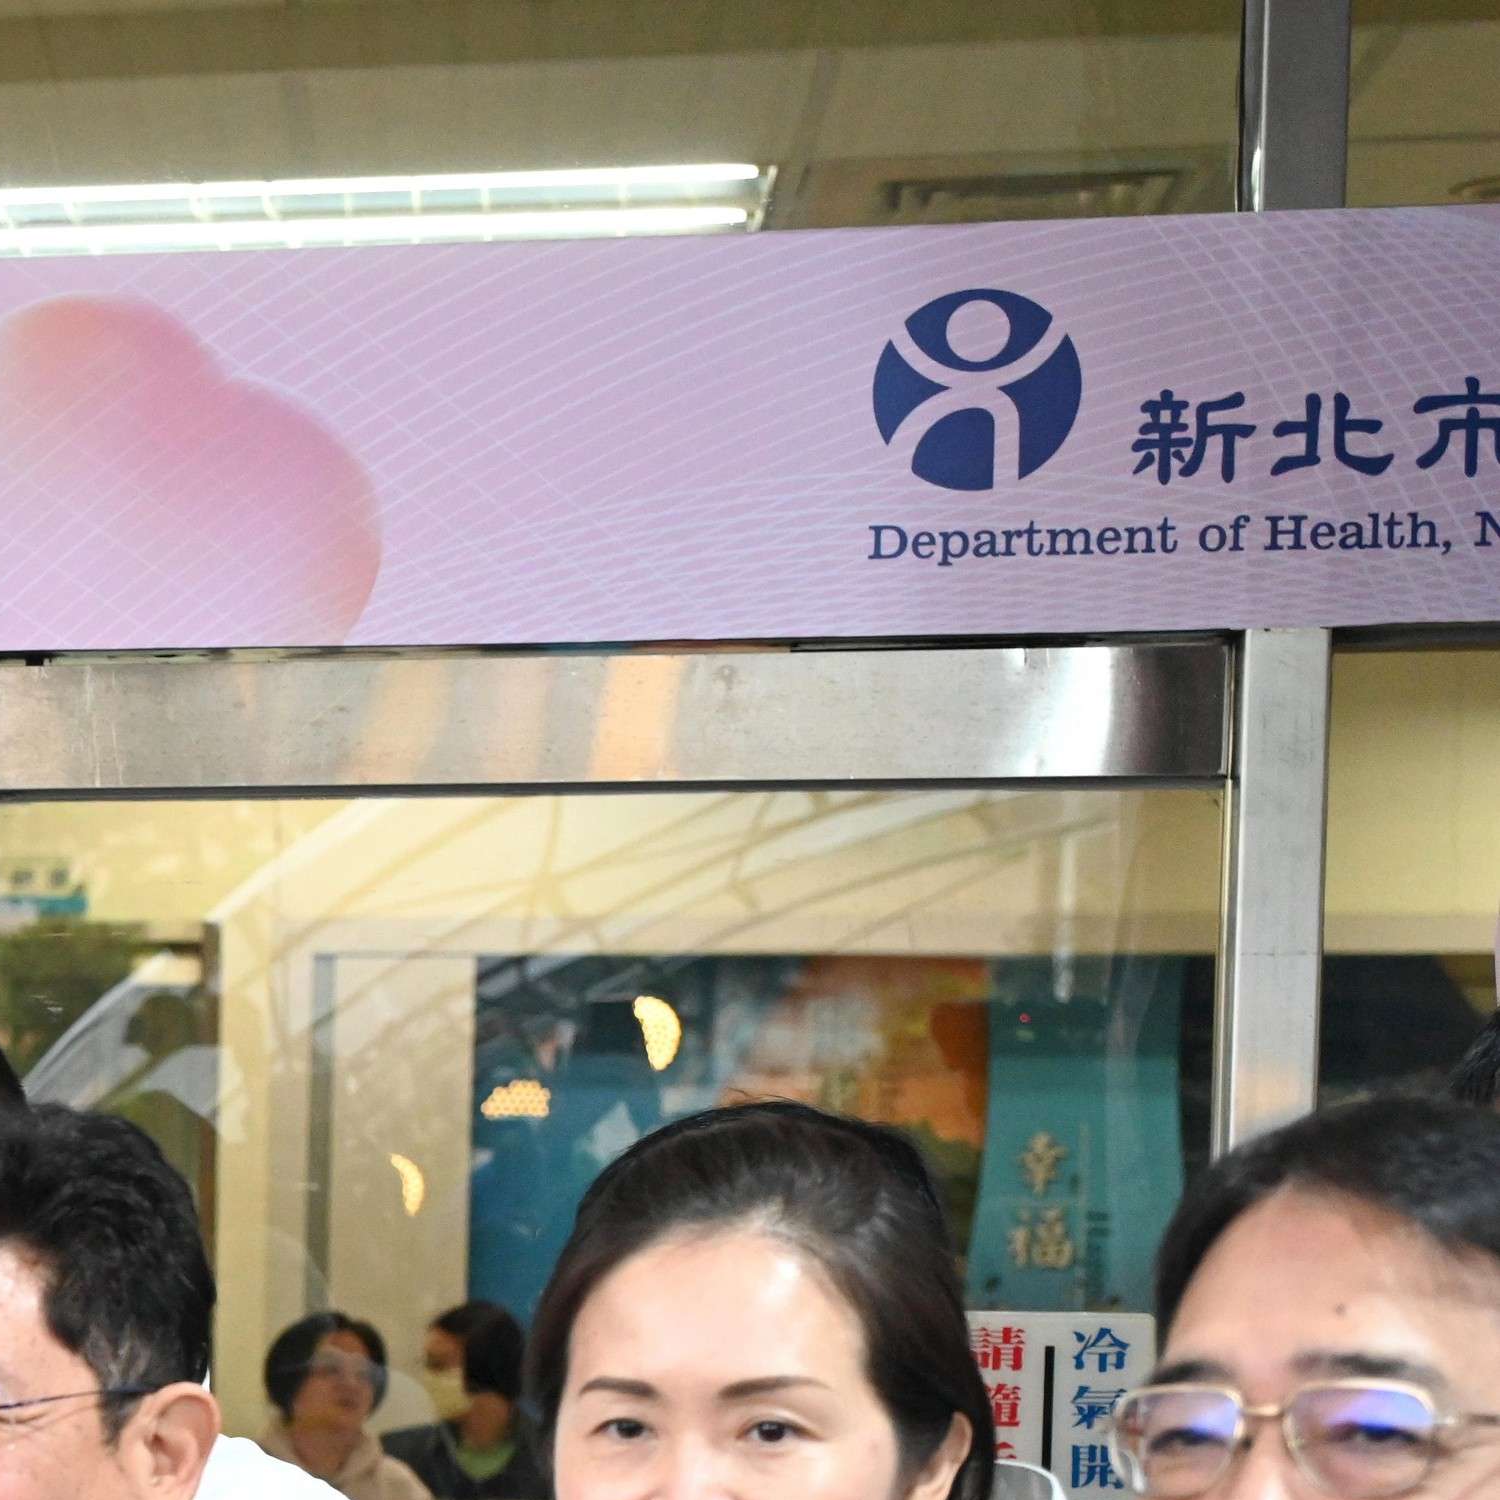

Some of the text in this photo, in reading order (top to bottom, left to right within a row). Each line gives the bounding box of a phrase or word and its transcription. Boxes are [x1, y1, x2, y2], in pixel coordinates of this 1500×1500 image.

[1130, 375, 1500, 486] 新北市
[867, 517, 1179, 567] Department
[1198, 514, 1252, 553] of
[1263, 511, 1453, 556] Health,
